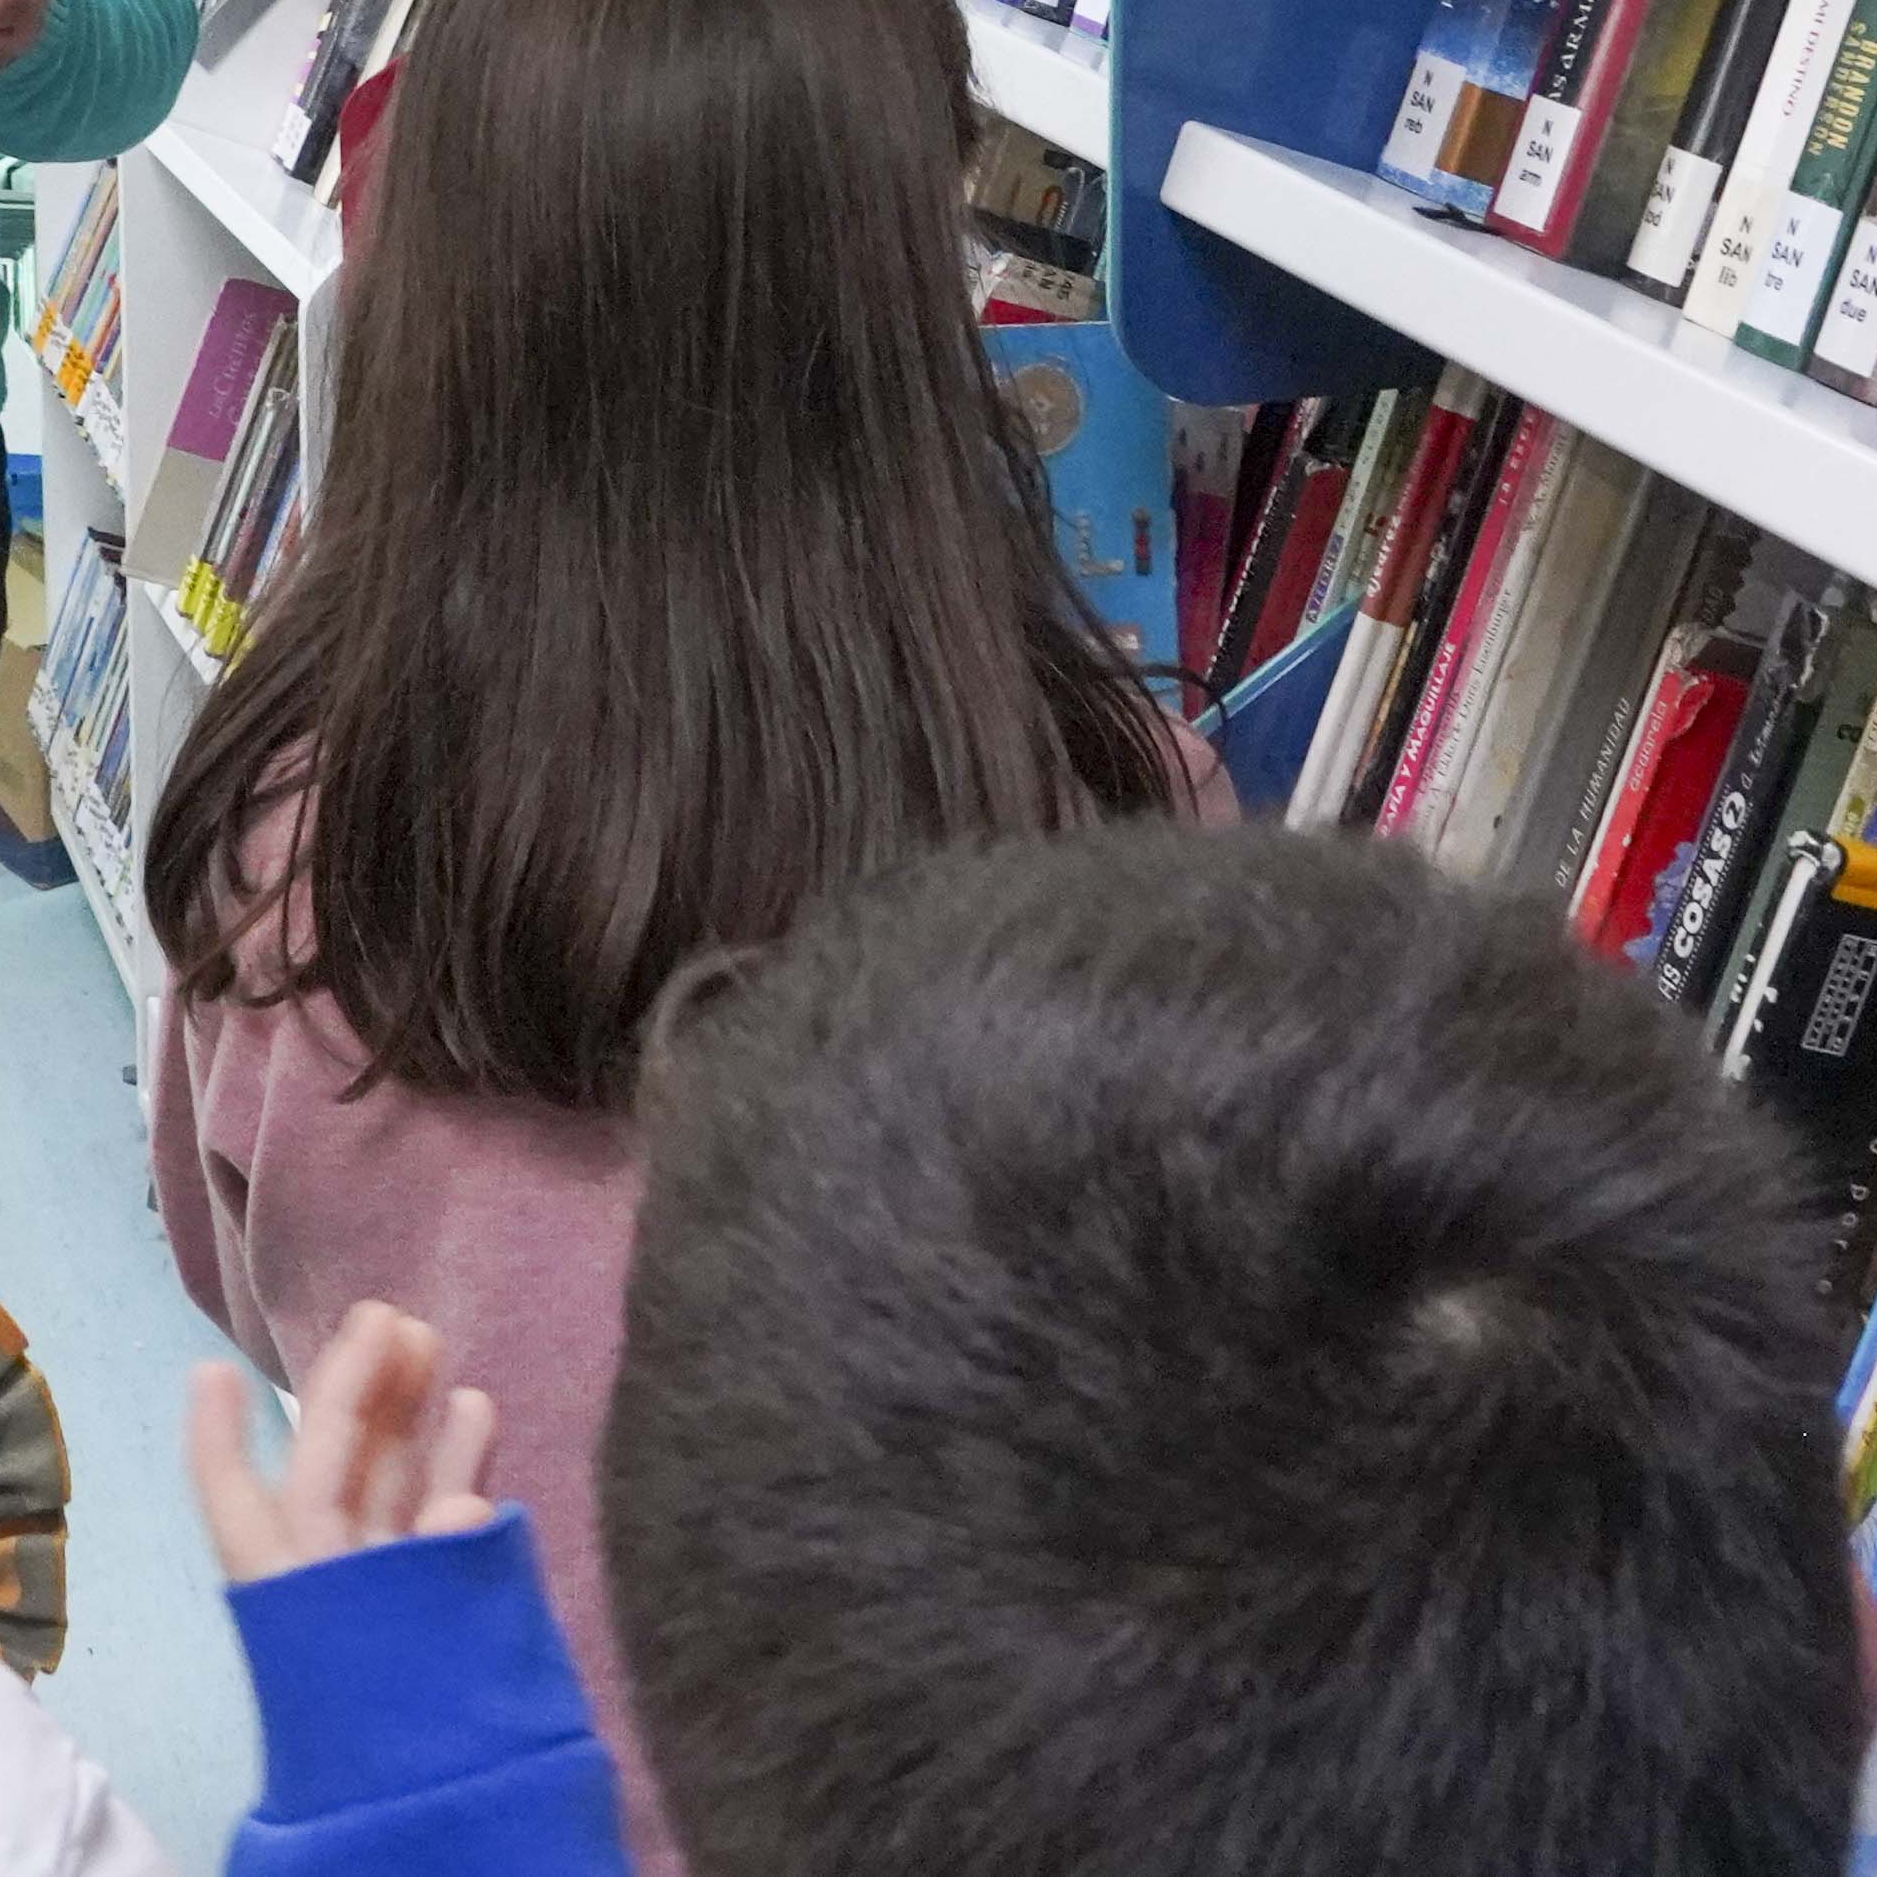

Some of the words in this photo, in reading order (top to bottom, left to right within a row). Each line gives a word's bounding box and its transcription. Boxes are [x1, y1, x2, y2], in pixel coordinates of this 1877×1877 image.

[1422, 70, 1434, 87] N
[1780, 28, 1822, 120] DESTINO
[1409, 91, 1435, 114] SAN
[1403, 117, 1424, 135] reb
[1541, 118, 1553, 137] N
[1525, 140, 1553, 164] SAN
[1739, 215, 1753, 234] N
[1786, 217, 1800, 235] N
[1720, 238, 1754, 265] SAN
[1771, 242, 1804, 268] SAN
[1839, 297, 1867, 323] due
[1400, 640, 1464, 763] MAQUILLAJE
[1624, 697, 1672, 794] acuarela
[1551, 865, 1571, 888] DE
[1563, 826, 1585, 856] LA
[1576, 694, 1632, 820] HUMANIDAD
[1668, 826, 1735, 962] COSAS
